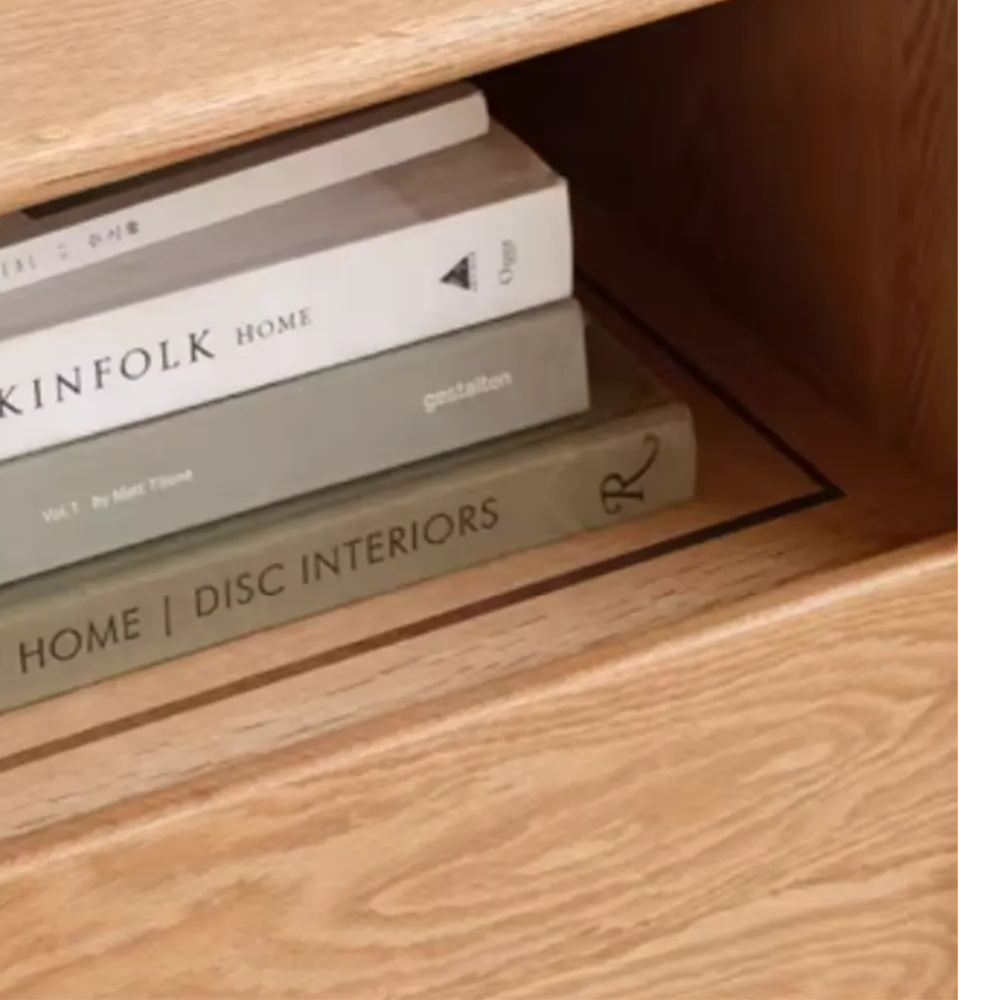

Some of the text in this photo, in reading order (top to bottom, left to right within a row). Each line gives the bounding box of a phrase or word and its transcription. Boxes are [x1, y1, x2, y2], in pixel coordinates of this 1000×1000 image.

[235, 307, 314, 346] HOME
[423, 370, 513, 414] gestalten
[18, 605, 142, 675] HOME
[194, 562, 286, 619] DISC
[300, 496, 500, 586] INTERIORS
